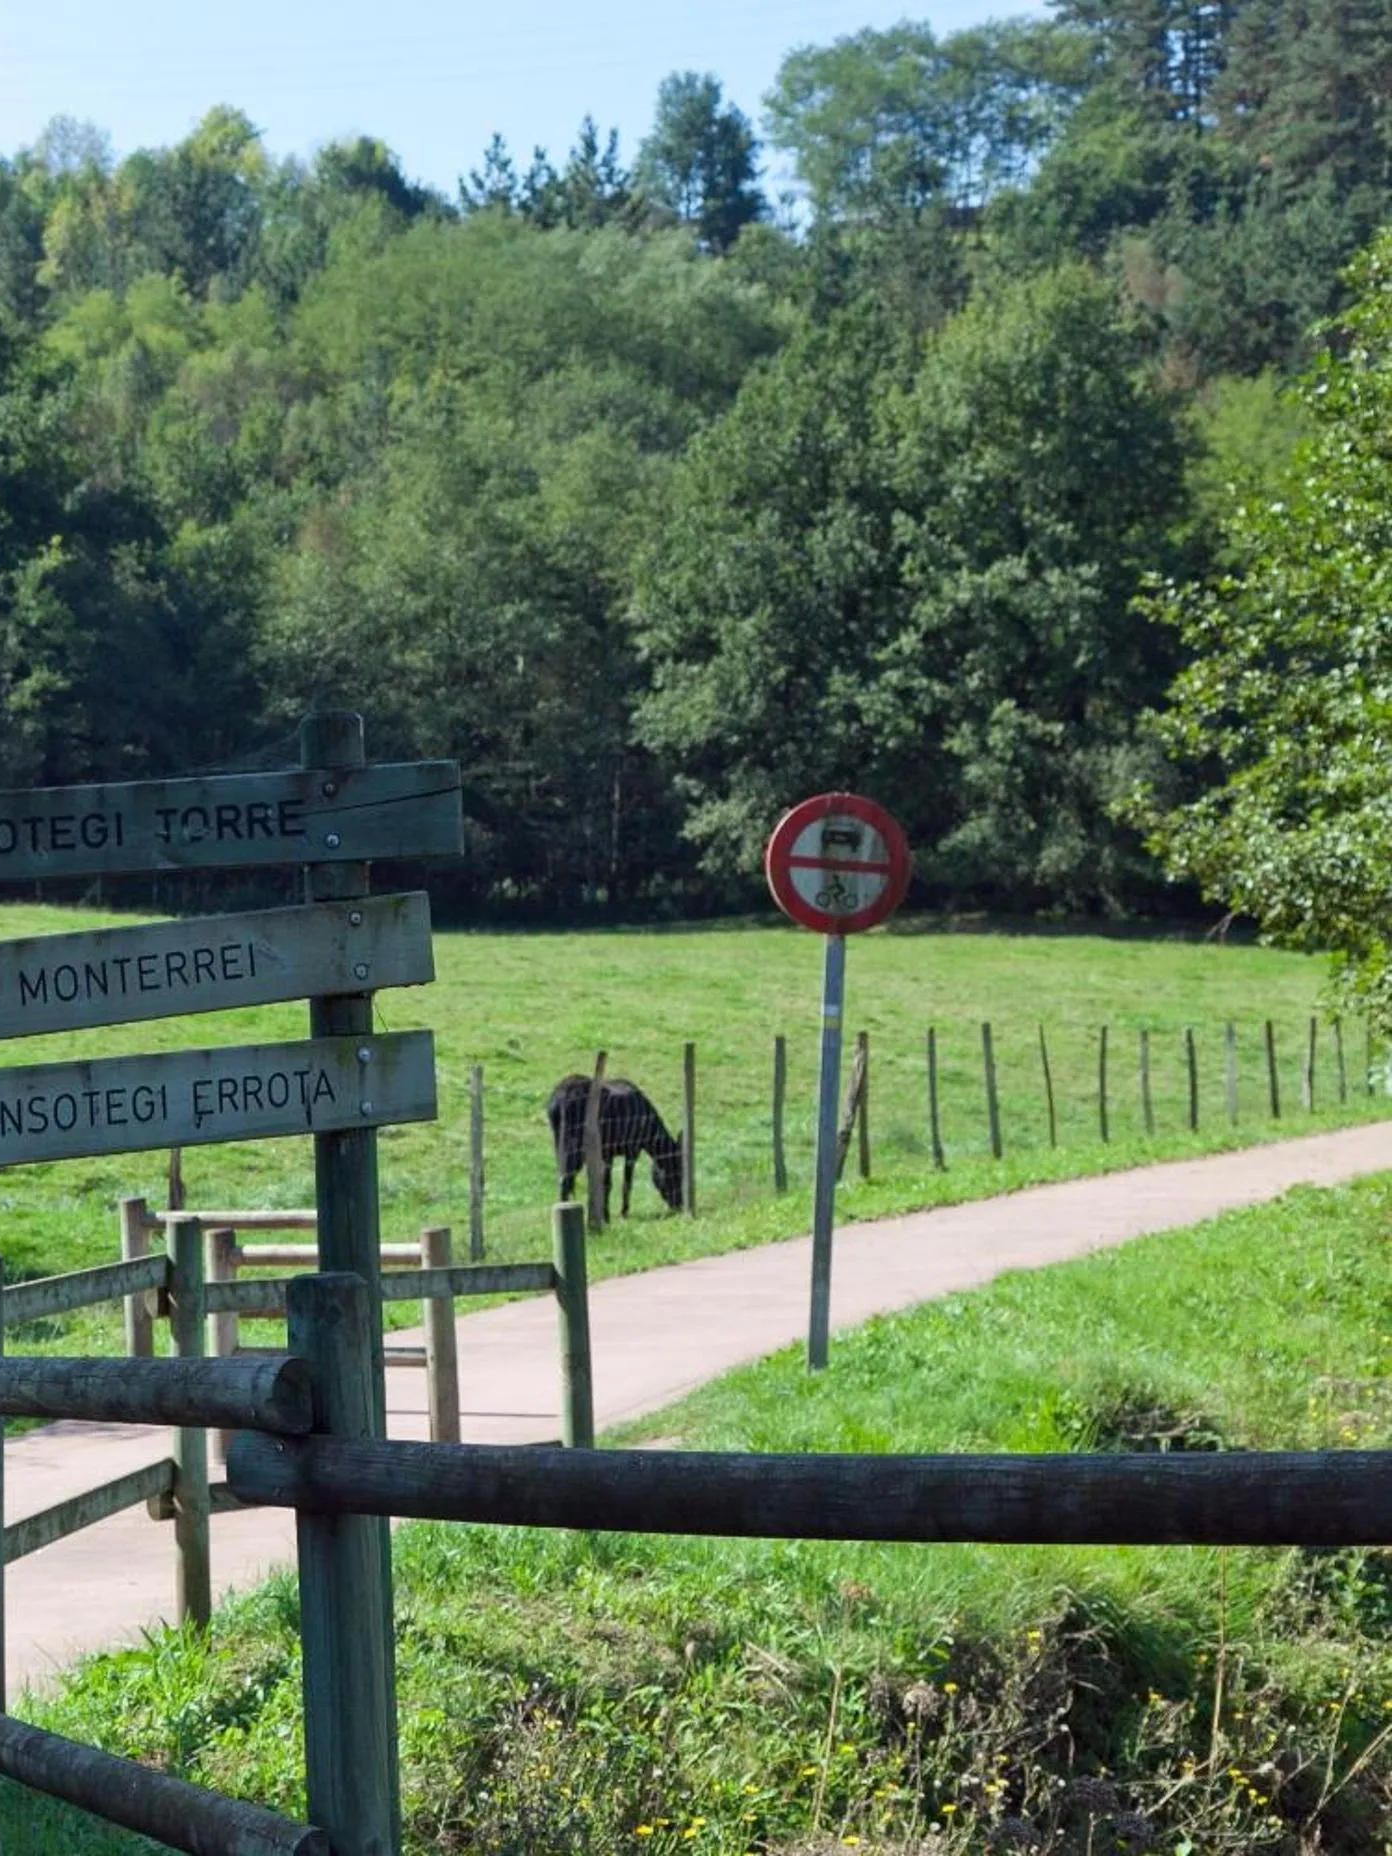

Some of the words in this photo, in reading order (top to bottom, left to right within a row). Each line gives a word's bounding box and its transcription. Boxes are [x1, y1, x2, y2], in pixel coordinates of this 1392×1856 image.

[155, 800, 307, 843] TORRE
[19, 942, 255, 1006] MONTERREI
[194, 1068, 336, 1118] ERROTA
